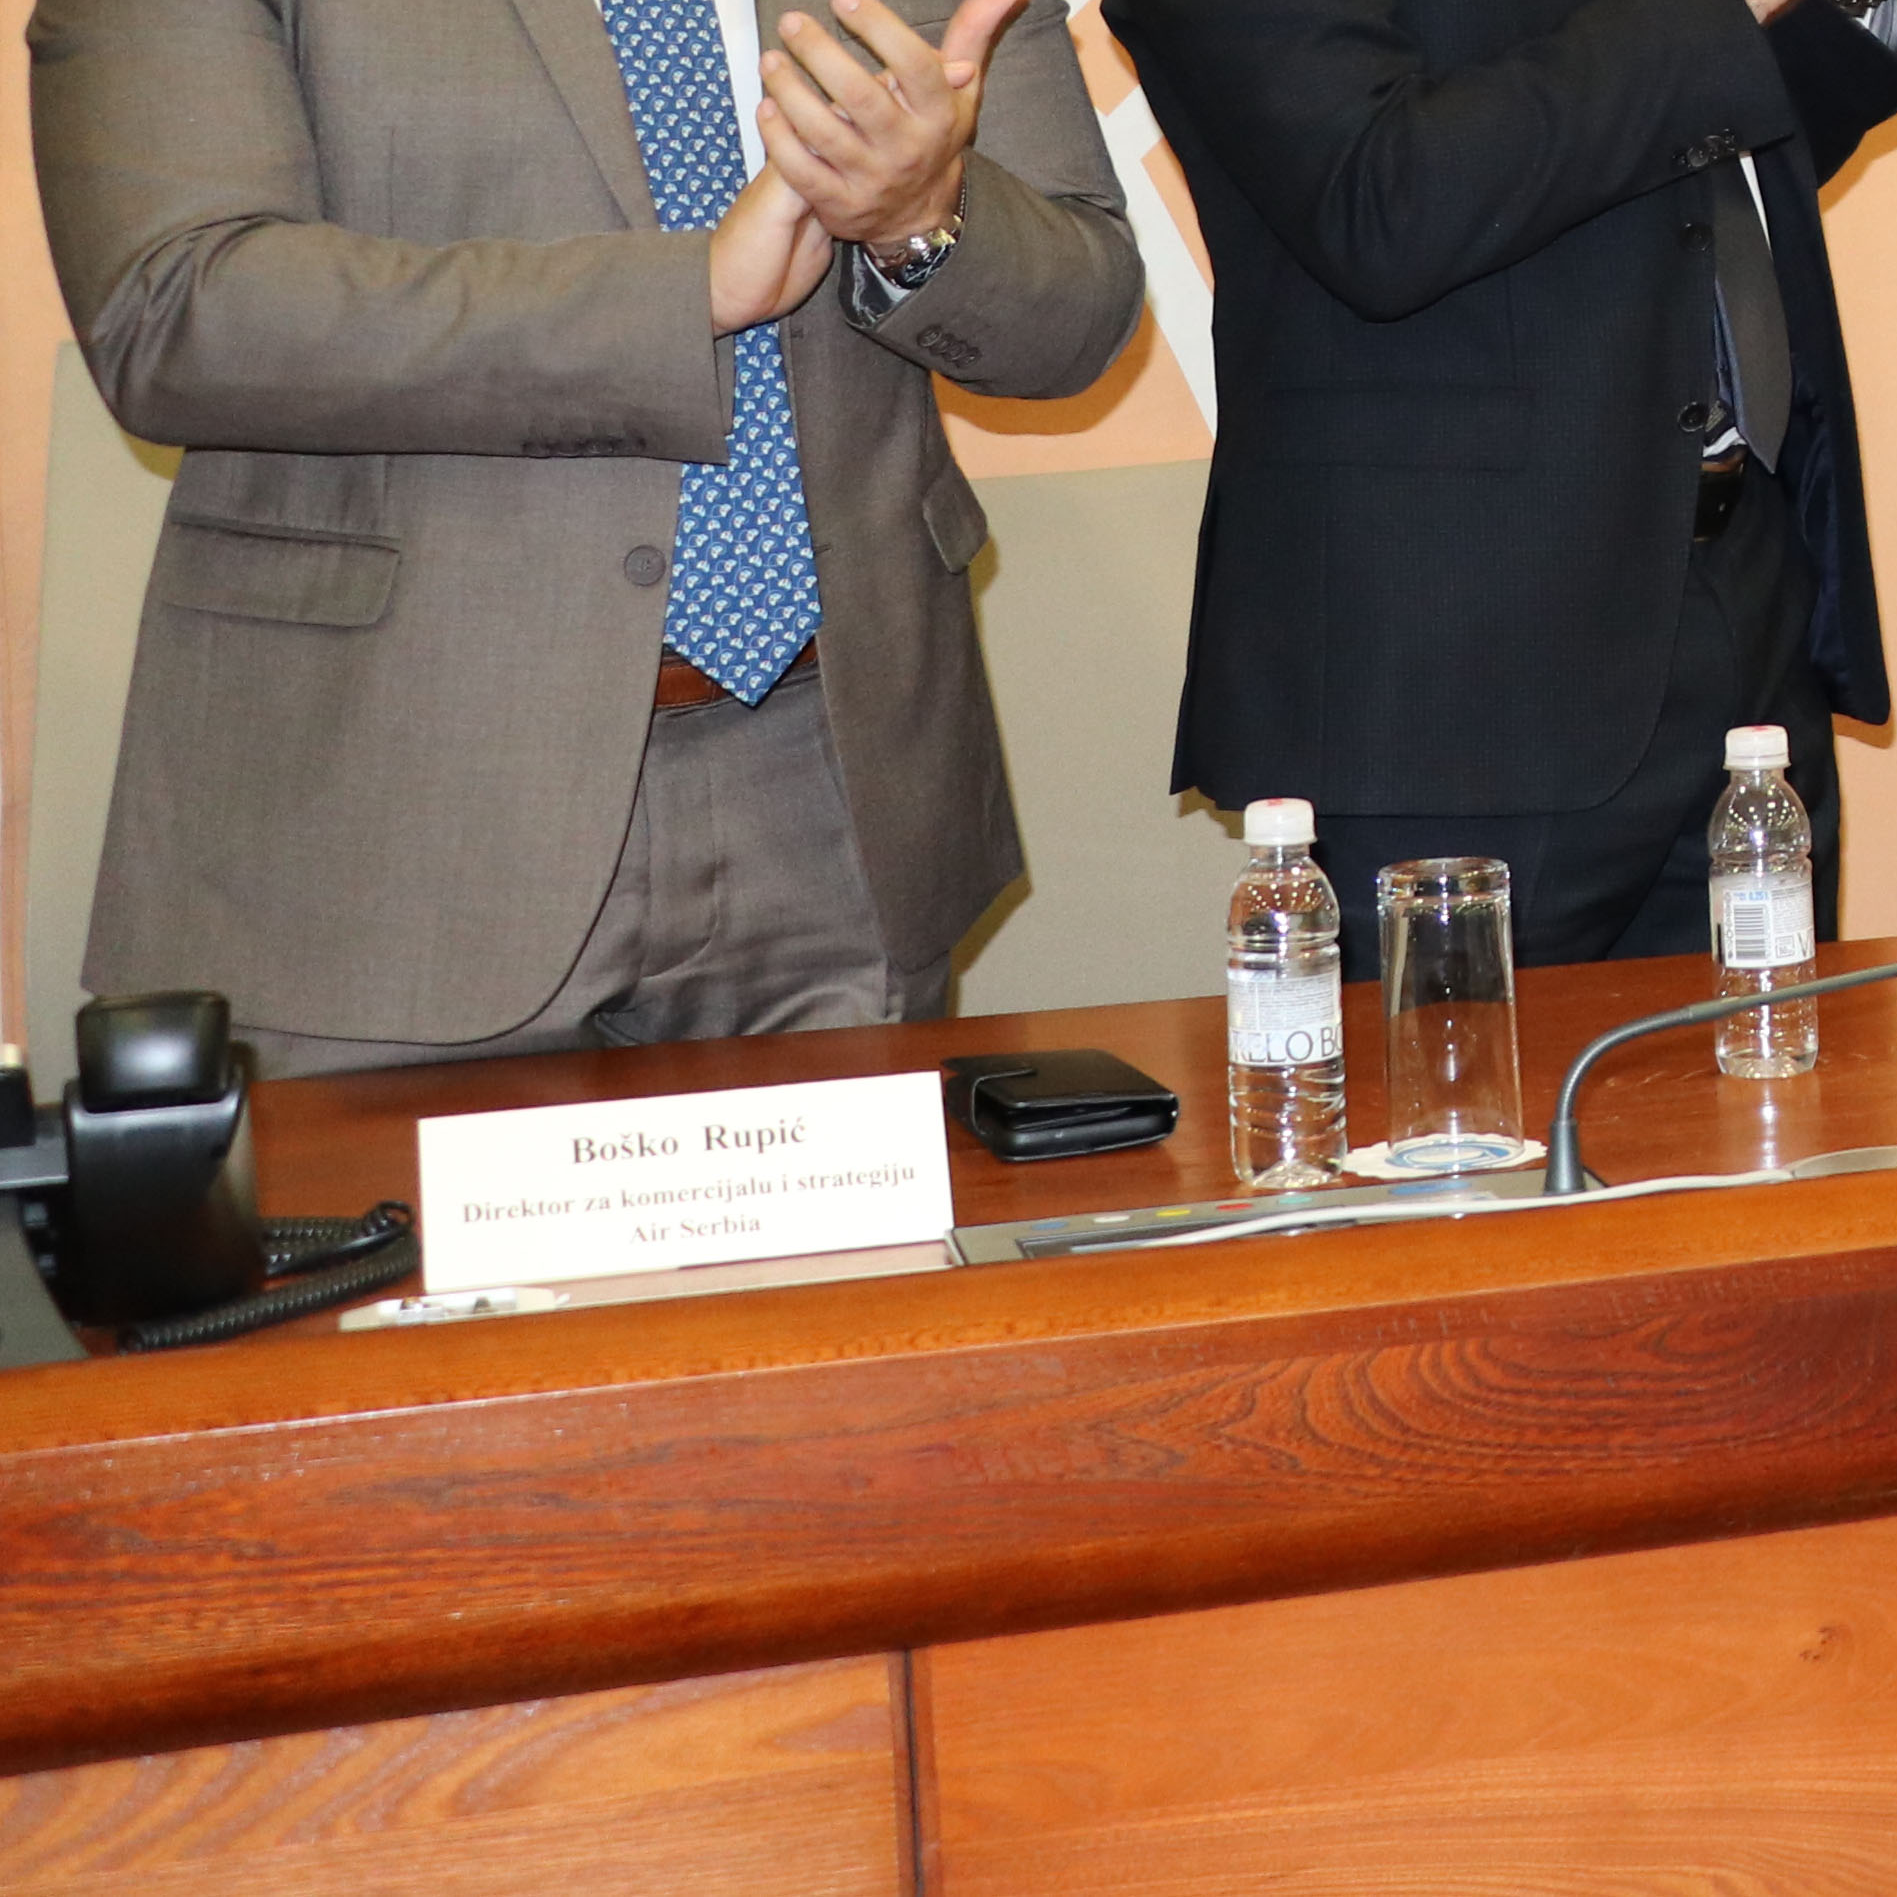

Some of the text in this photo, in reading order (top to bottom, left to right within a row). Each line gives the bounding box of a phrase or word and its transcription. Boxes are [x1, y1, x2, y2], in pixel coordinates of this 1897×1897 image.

[572, 1116, 807, 1165] Boško Rupić
[463, 1162, 917, 1223] Direktor za komercijalu i strategiju
[630, 1214, 762, 1244] Air Serbia
